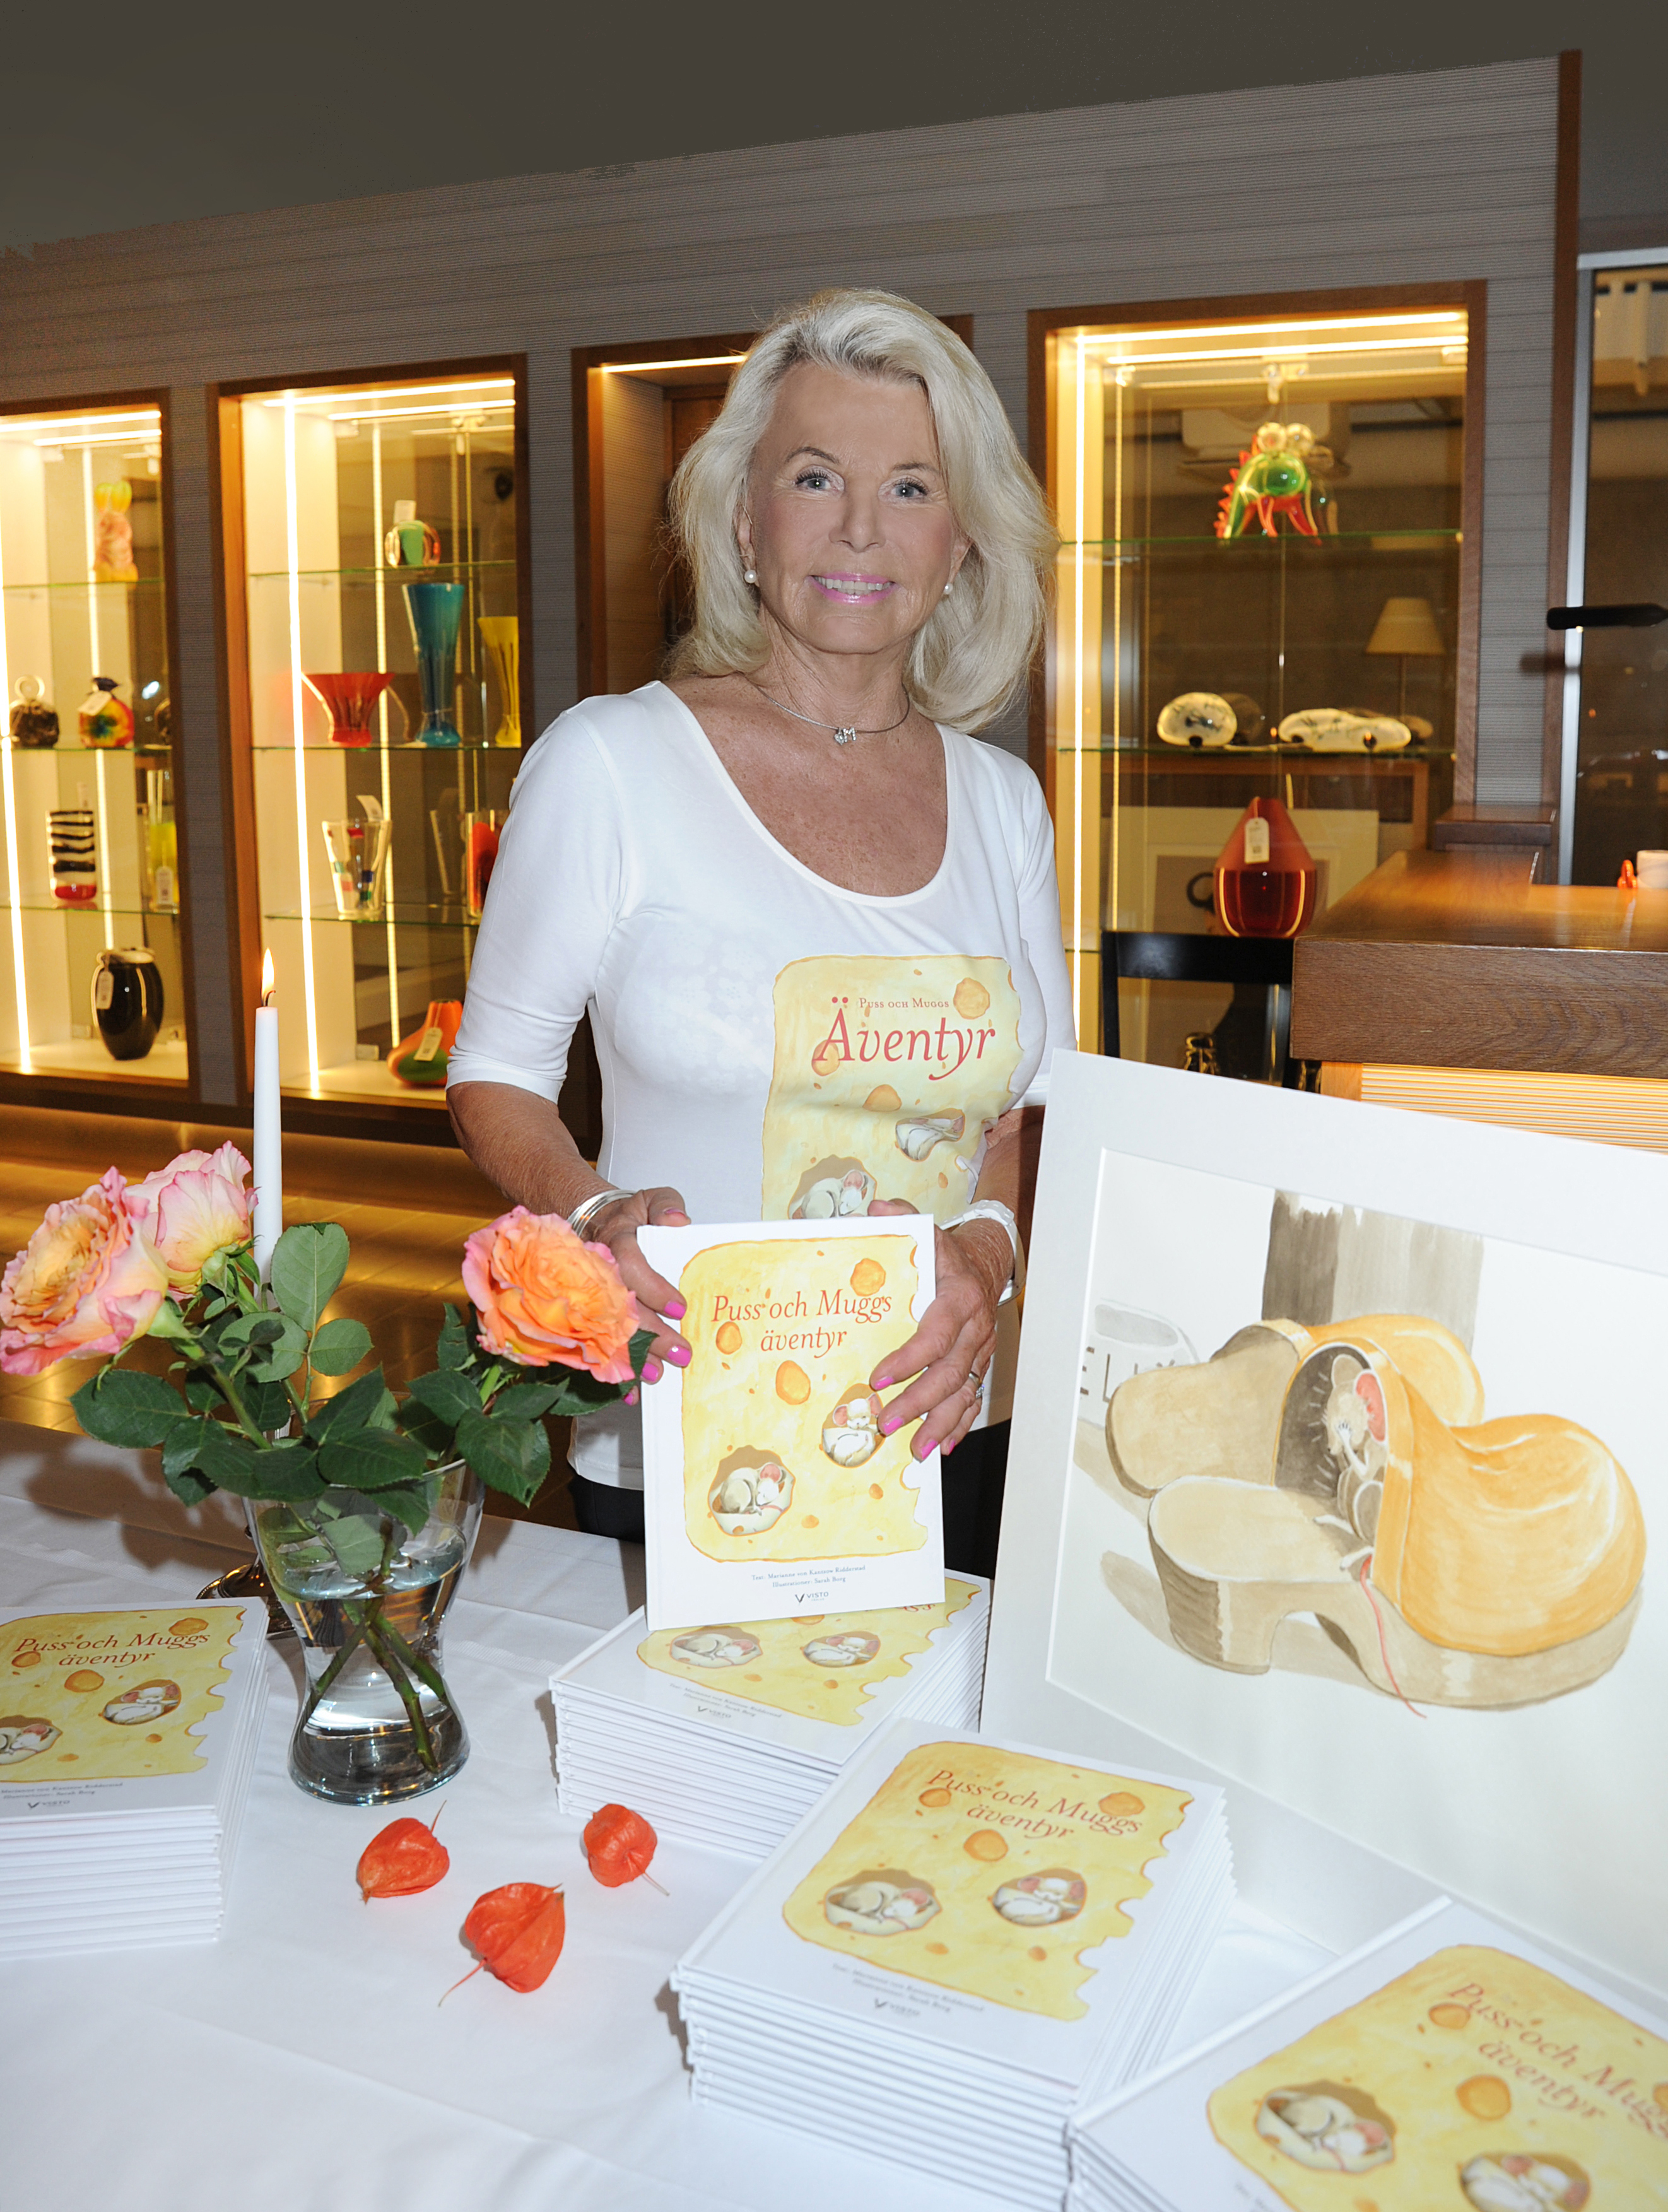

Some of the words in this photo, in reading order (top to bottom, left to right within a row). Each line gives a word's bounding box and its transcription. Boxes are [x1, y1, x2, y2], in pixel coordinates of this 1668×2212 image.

[811, 996, 996, 1081] Äventyr
[711, 1295, 761, 1322] Puss
[769, 1291, 808, 1319] och
[816, 1288, 892, 1324] Muggs
[760, 1326, 847, 1358] äventyr
[14, 1638, 69, 1652] Puss
[76, 1635, 119, 1650] och
[126, 1632, 211, 1650] Muggs
[59, 1651, 156, 1668] äventyr
[927, 1769, 985, 1796] Puss
[992, 1791, 1039, 1809] och
[1047, 1797, 1143, 1837] Muggs
[966, 1804, 1075, 1840] äventyr
[1447, 1982, 1511, 2030] Puss
[1519, 2030, 1580, 2069] och
[1479, 2040, 1606, 2118] äventyr
